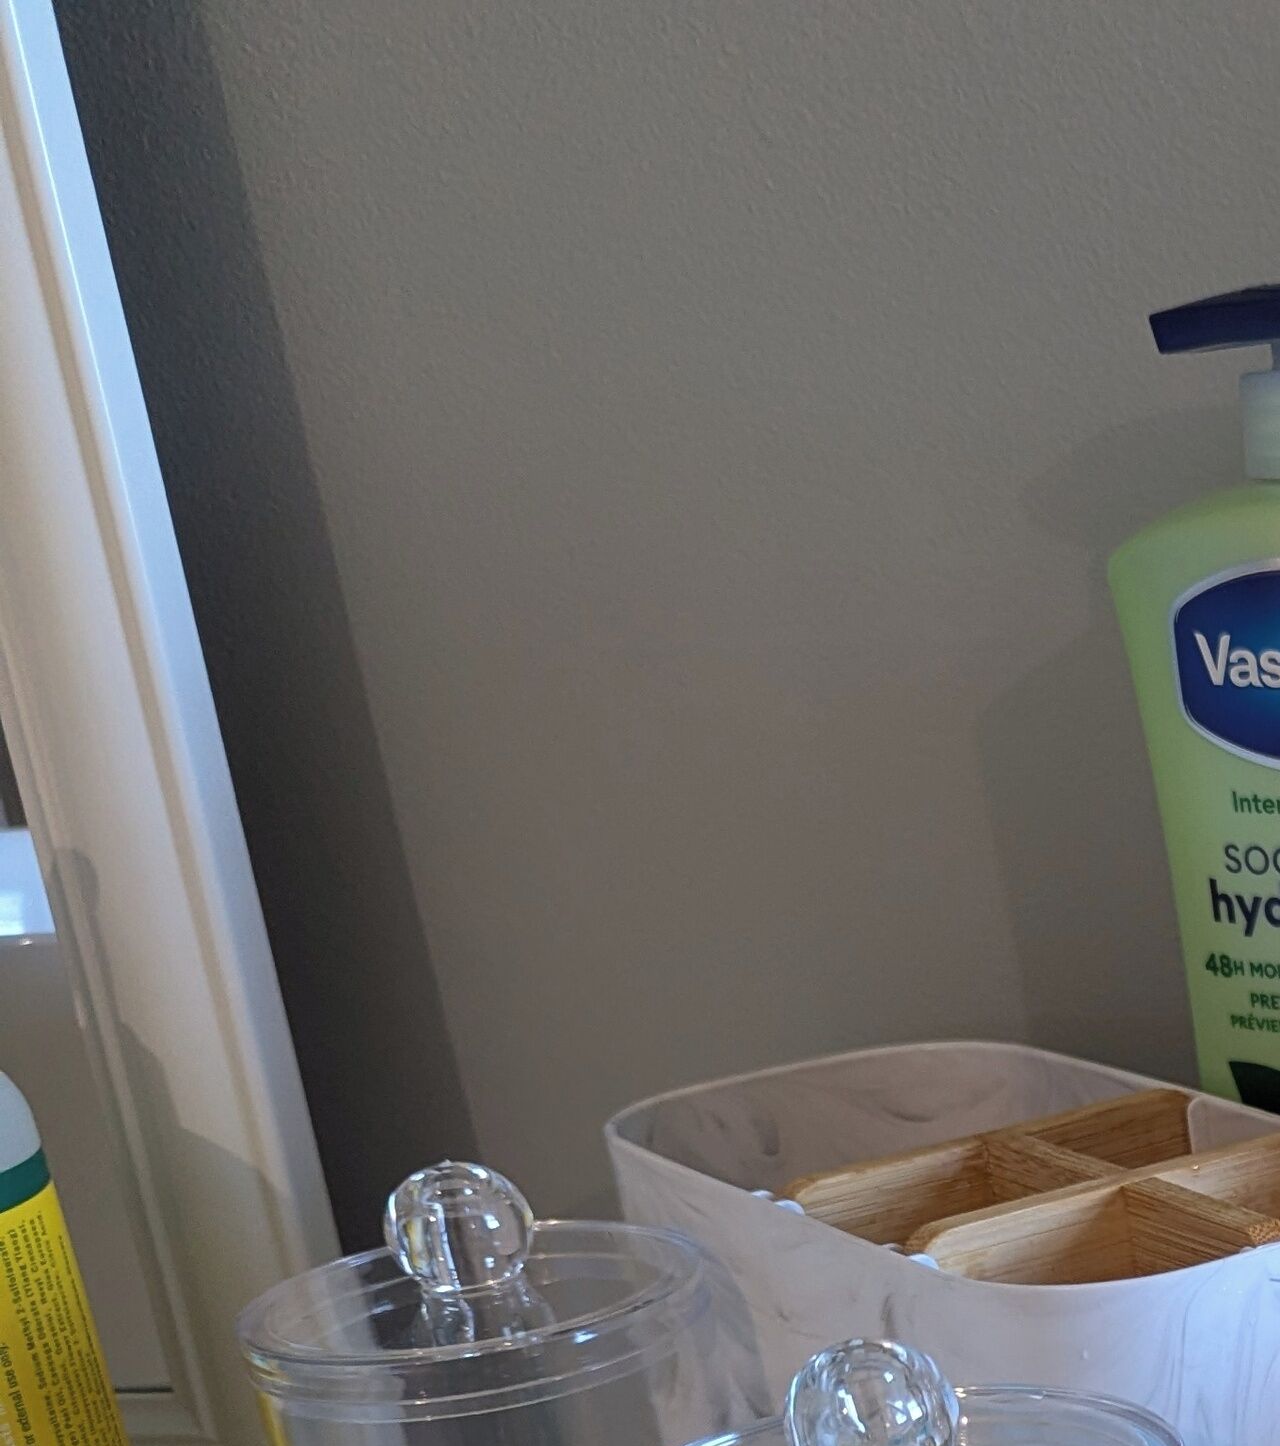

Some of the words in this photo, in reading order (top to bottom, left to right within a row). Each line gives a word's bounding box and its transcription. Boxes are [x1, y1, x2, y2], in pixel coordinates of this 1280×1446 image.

[1205, 953, 1245, 979] 48H
[3, 1367, 19, 1389] use
[7, 1389, 32, 1433] external
